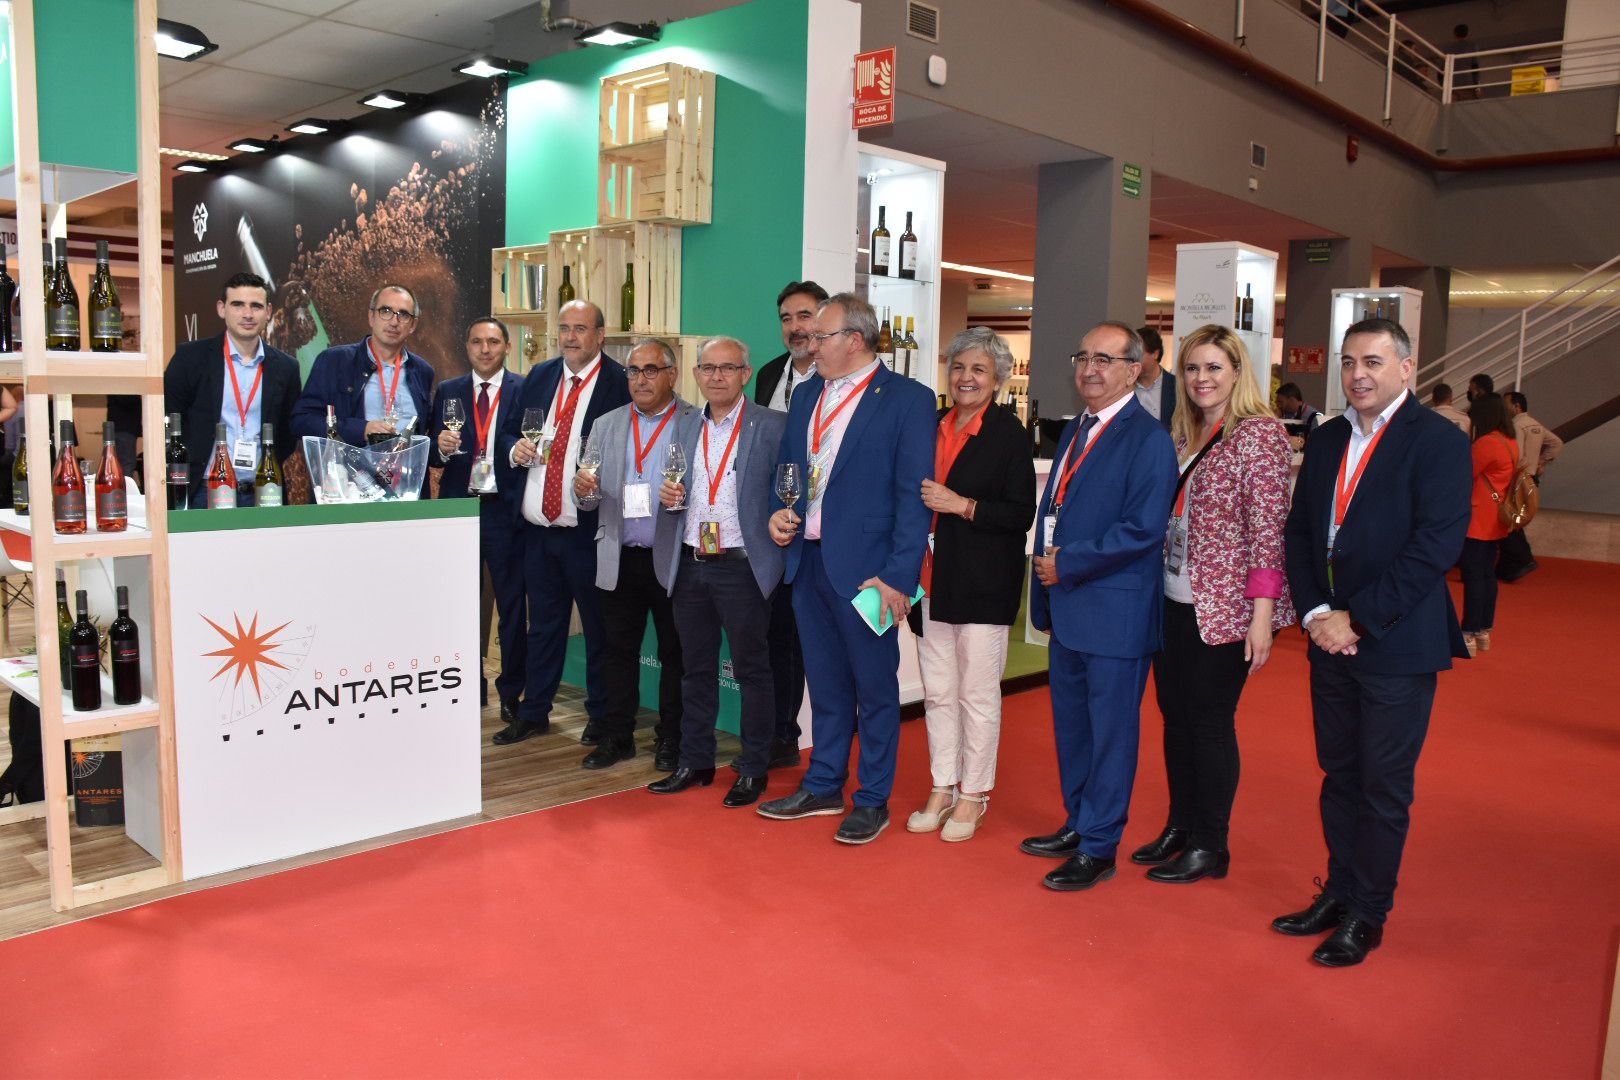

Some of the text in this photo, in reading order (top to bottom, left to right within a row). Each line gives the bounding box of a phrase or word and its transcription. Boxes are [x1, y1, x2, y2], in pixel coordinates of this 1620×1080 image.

[857, 114, 888, 124] INCENDIO
[184, 247, 219, 265] MANCHUELA
[314, 651, 461, 681] bodegas
[284, 667, 462, 715] ANTARES
[77, 788, 123, 796] ANTARES
